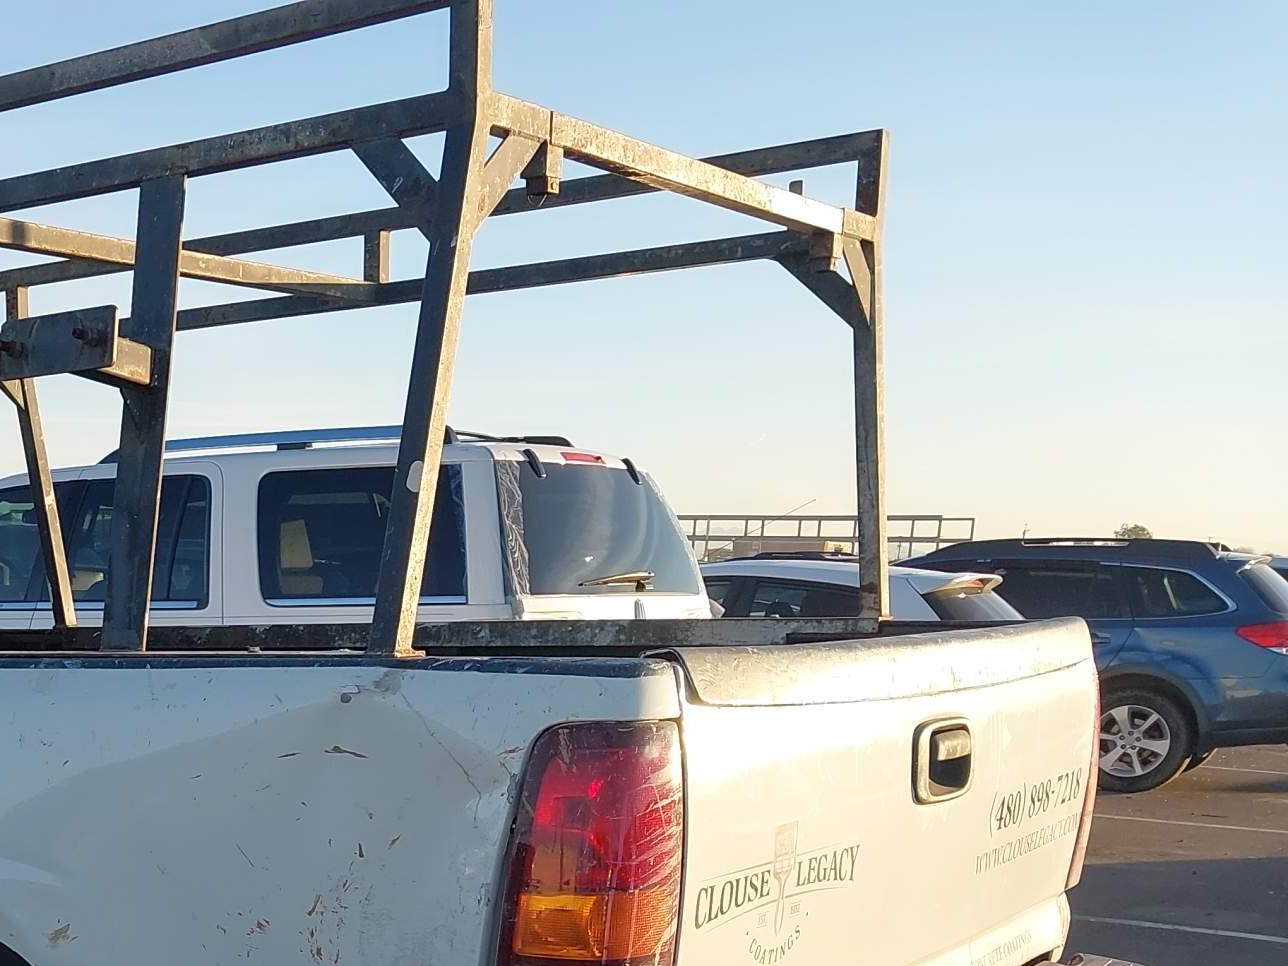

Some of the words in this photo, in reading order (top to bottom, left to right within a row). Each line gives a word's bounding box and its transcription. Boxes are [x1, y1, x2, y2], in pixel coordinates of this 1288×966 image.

[989, 781, 1027, 839] (480)
[1028, 767, 1083, 819] 898-7218
[694, 869, 772, 930] CLOUSE
[796, 844, 861, 888] LEGACY
[749, 924, 802, 965] COATINGS
